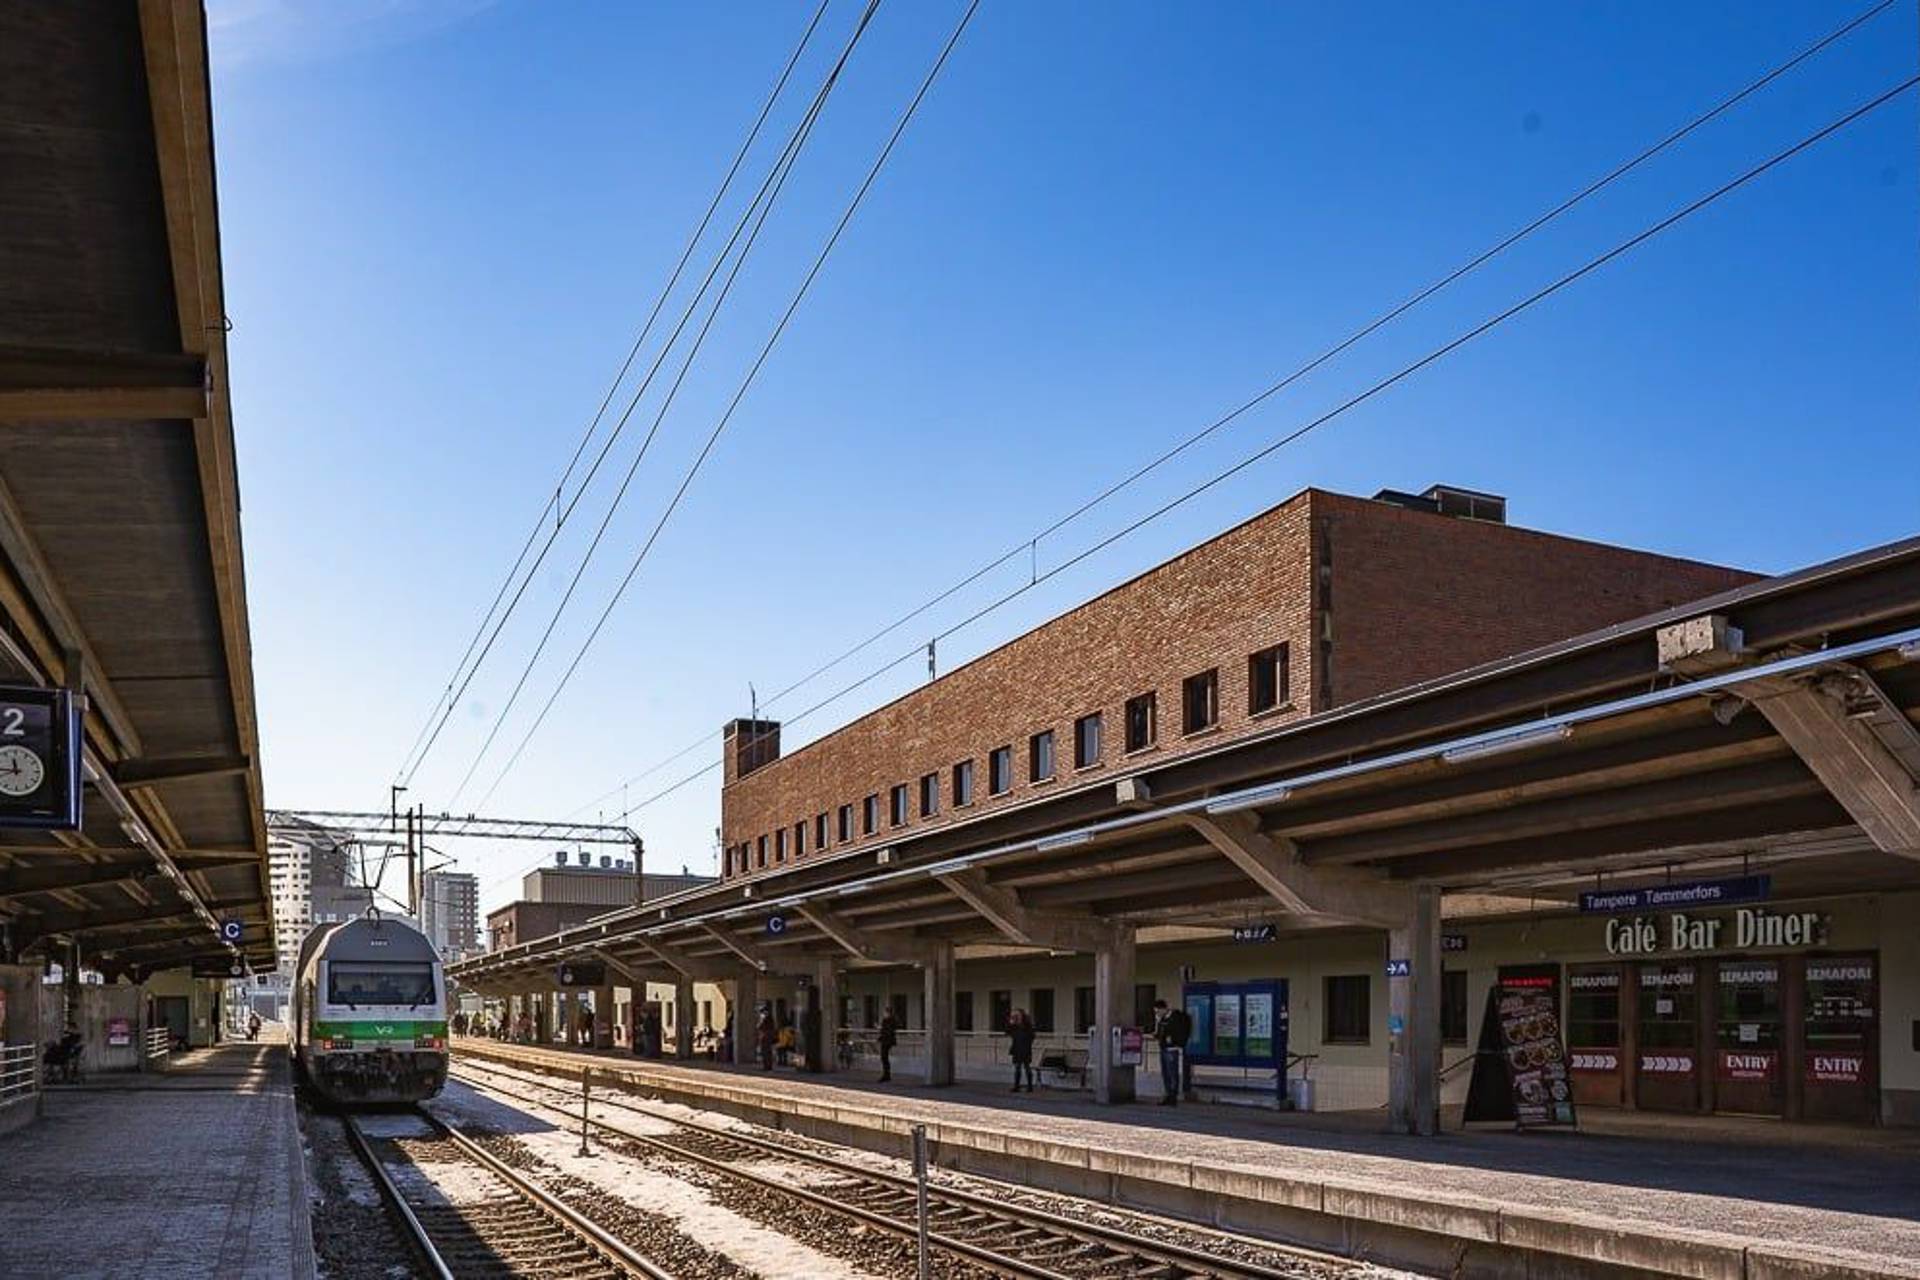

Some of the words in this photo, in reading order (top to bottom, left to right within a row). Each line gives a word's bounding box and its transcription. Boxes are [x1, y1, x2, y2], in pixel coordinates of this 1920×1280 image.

[3, 707, 25, 735] 2
[1587, 893, 1637, 911] Tampere
[1644, 884, 1722, 905] Tammerfors
[225, 923, 240, 939] C
[770, 916, 783, 932] C
[1605, 916, 1657, 954] Café
[1671, 913, 1722, 950] Bar
[1737, 908, 1819, 948] Diner
[1641, 972, 1694, 986] SEMAFORI
[1719, 969, 1779, 983] SEMAFORI
[1806, 967, 1872, 981] SEMAFORI
[375, 1025, 394, 1035] VR
[1727, 1054, 1770, 1070] ENTRY
[1814, 1057, 1863, 1073] ENTRY
